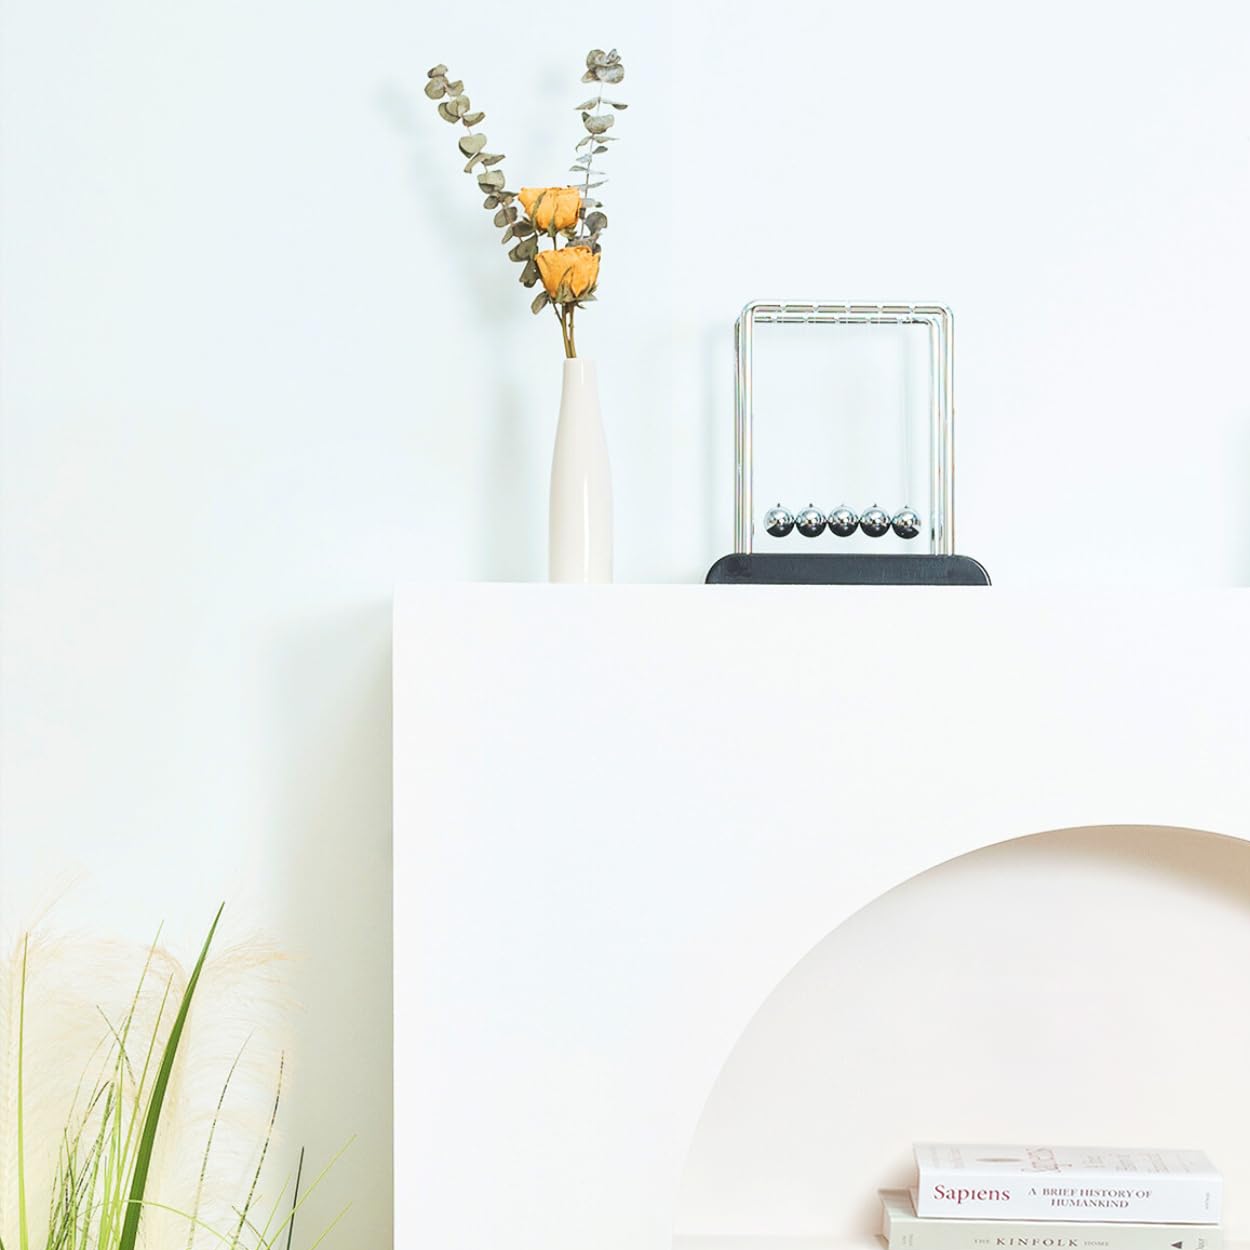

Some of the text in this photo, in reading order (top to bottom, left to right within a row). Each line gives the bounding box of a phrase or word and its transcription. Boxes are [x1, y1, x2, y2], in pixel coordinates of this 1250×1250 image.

[933, 1184, 1011, 1205] Sapiens
[1028, 1187, 1152, 1199] A BRIEF HISTORY OF
[1051, 1198, 1129, 1208] HUMANKIND
[996, 1238, 1079, 1247] KINFOLK
